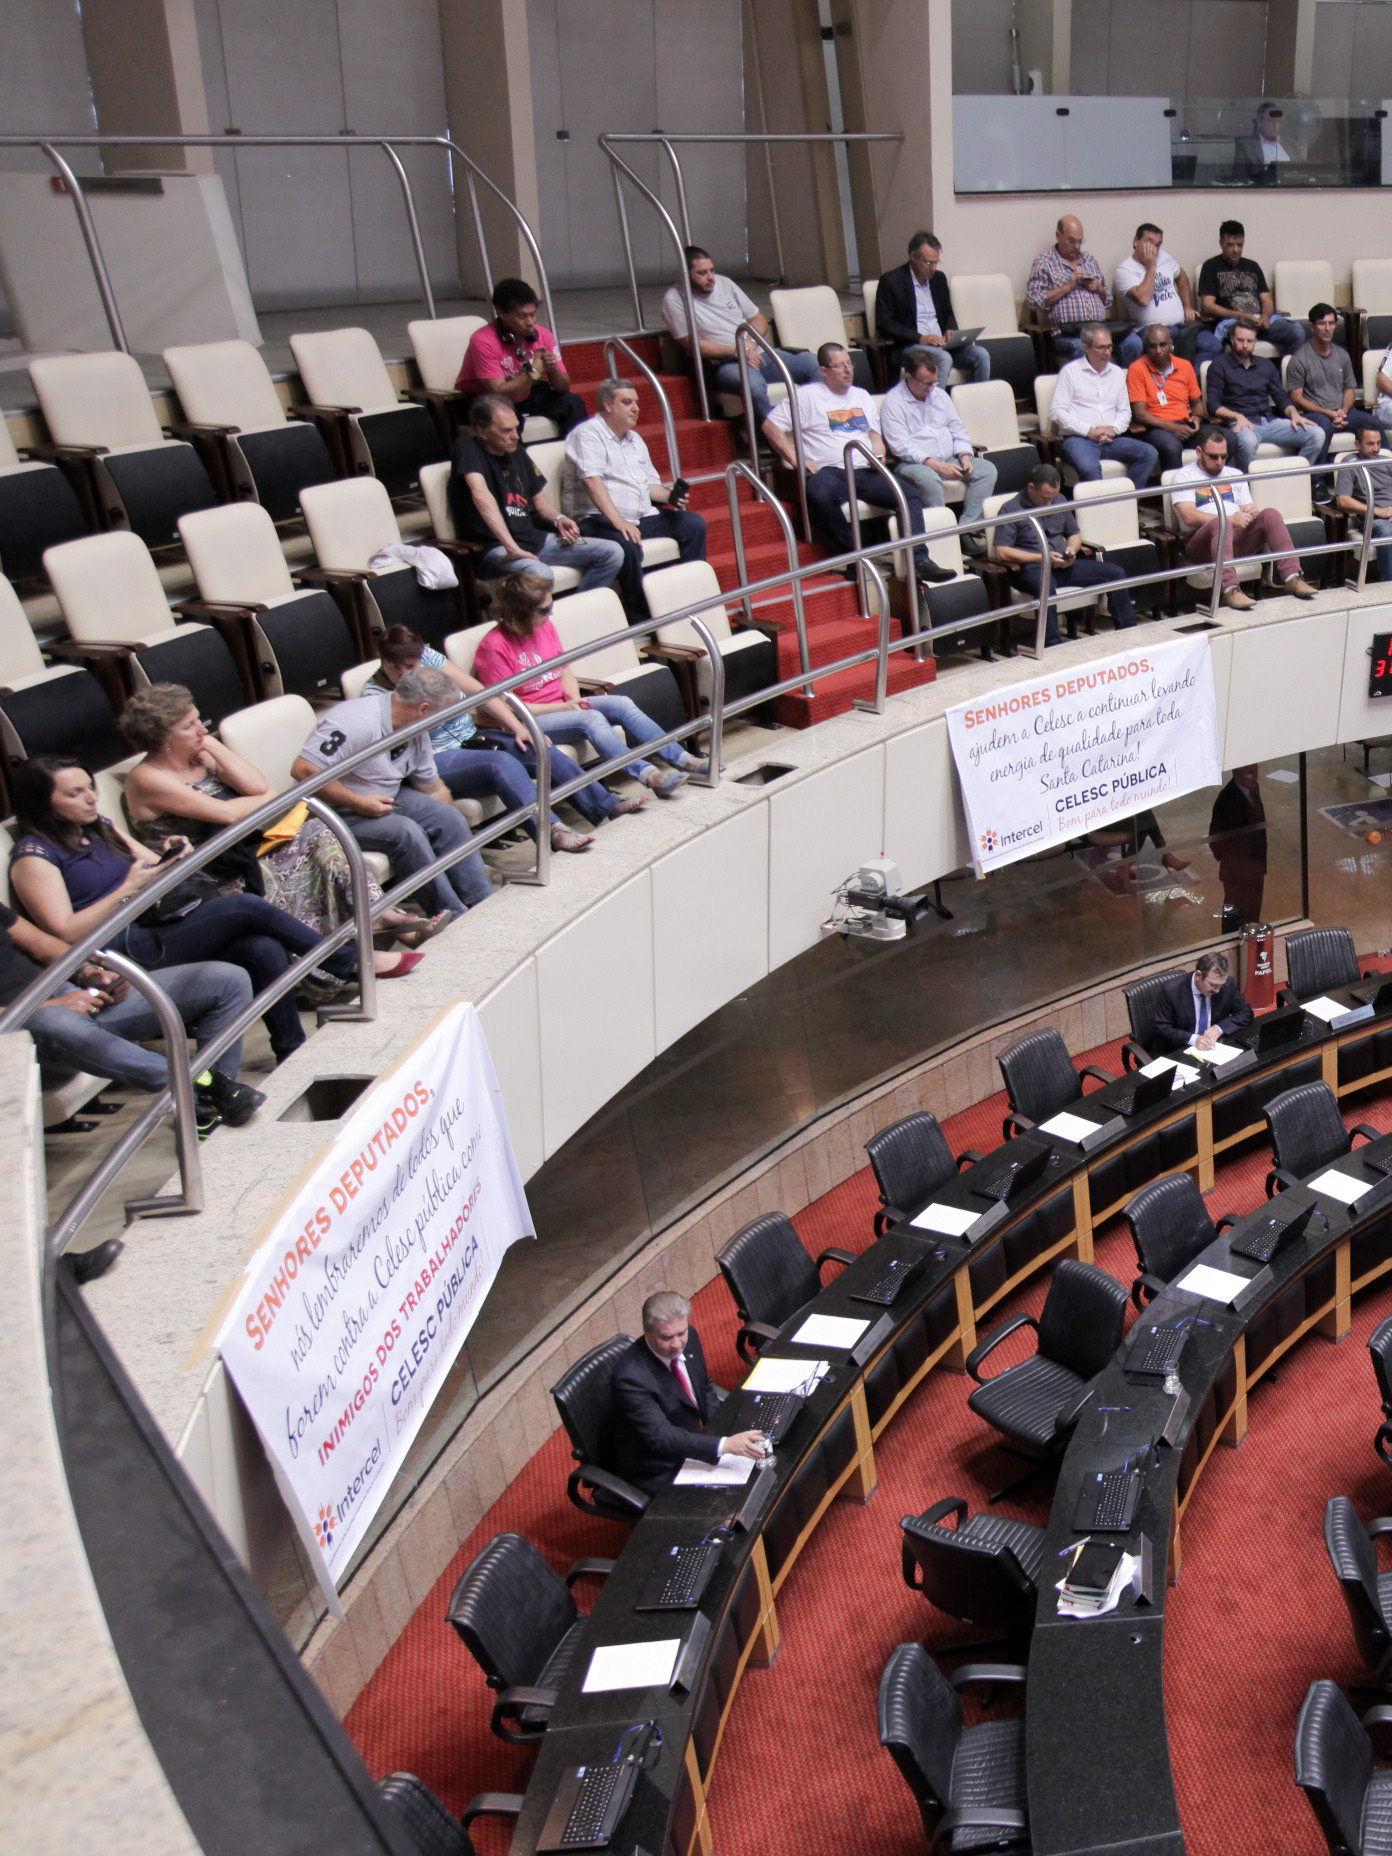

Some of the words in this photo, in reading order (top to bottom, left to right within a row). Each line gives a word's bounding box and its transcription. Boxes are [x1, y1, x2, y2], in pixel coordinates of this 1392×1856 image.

[965, 687, 1051, 729] SENHORES
[1055, 658, 1155, 699] DEPUTADOS,
[969, 727, 1021, 767] ajudem
[1021, 727, 1031, 740] a
[1034, 704, 1075, 736] Celesc
[1076, 710, 1086, 723] a
[1088, 692, 1149, 719] continuar
[1151, 668, 1196, 699] levando
[319, 730, 347, 757] 3
[989, 757, 1038, 784] energia
[1040, 737, 1056, 763] de
[1058, 723, 1124, 768] qualidade
[1124, 718, 1155, 748] para
[1155, 701, 1184, 726] toda
[1040, 767, 1078, 795] Santa
[1082, 741, 1141, 778] Catarina!
[1055, 784, 1109, 813] CELESC
[1112, 762, 1167, 793] PÚBLICA
[1058, 815, 1084, 832] Bom
[1084, 806, 1110, 830] para
[1110, 791, 1134, 813] todo
[1133, 774, 1171, 807] mundo!
[1000, 820, 1043, 848] Intercel
[246, 1207, 331, 1350] SENHORES
[329, 1081, 435, 1215] DEPUTADOS,
[290, 1324, 314, 1372] nós
[303, 1196, 391, 1331] lembraremos
[392, 1164, 407, 1202] de
[408, 1127, 439, 1180] todos
[440, 1098, 464, 1151] que
[286, 1374, 337, 1460] forem
[334, 1310, 369, 1375] contra
[369, 1289, 379, 1311] a
[374, 1227, 418, 1289] Celesc
[414, 1165, 462, 1253] pública
[318, 1362, 379, 1466] INIMIGOS
[376, 1319, 402, 1367] DOS
[399, 1177, 482, 1320] TRABALHADORES
[391, 1315, 437, 1406] CELESC
[437, 1234, 479, 1322] PÚBLICA
[336, 1437, 382, 1523] Intercel
